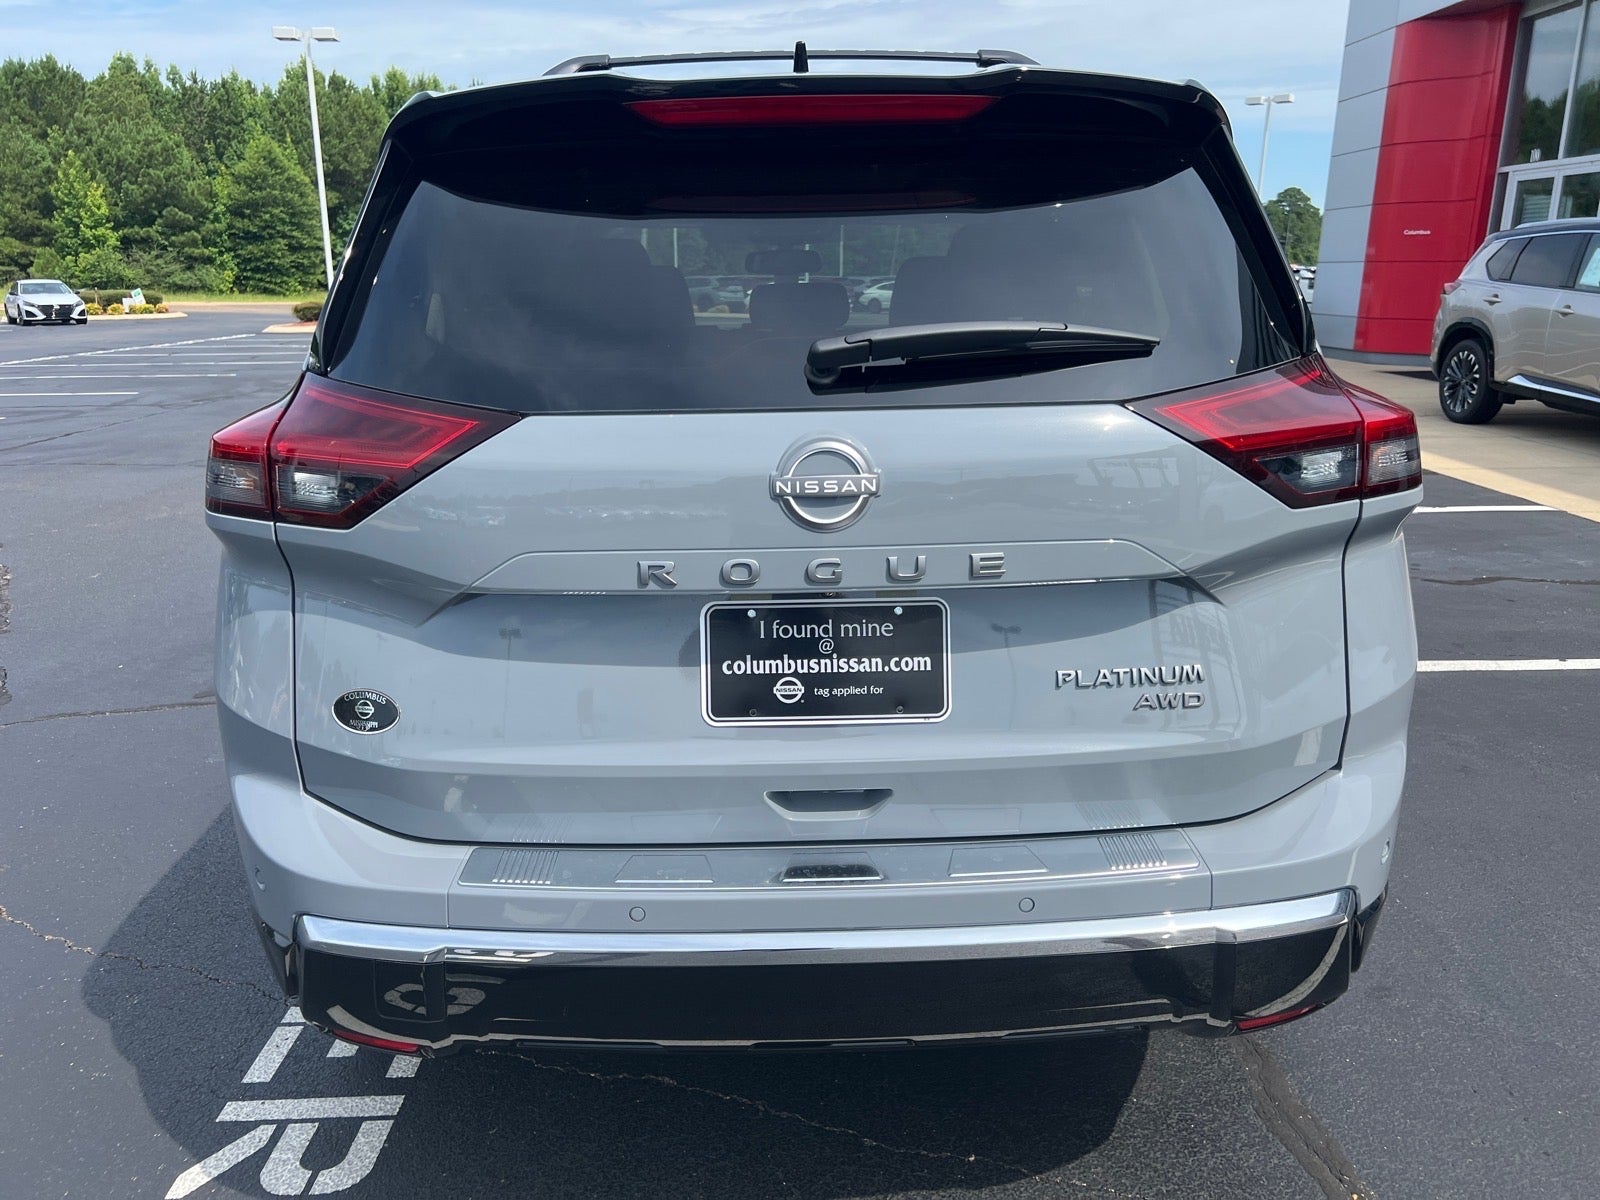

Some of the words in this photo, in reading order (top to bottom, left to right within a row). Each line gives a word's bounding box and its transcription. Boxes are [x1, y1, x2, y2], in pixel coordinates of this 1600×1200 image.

[775, 479, 877, 494] NISSAN
[637, 552, 1006, 588] ROGUE
[759, 621, 766, 639] I
[772, 619, 833, 639] found
[840, 619, 894, 637] mine
[818, 638, 835, 655] @
[721, 653, 932, 675] columbusnissan.com
[1055, 664, 1206, 690] PLATINUM
[344, 692, 386, 704] COLUMBUS
[813, 687, 830, 698] tag
[832, 685, 867, 697] applied
[870, 685, 884, 694] for
[1132, 691, 1206, 711] AWD
